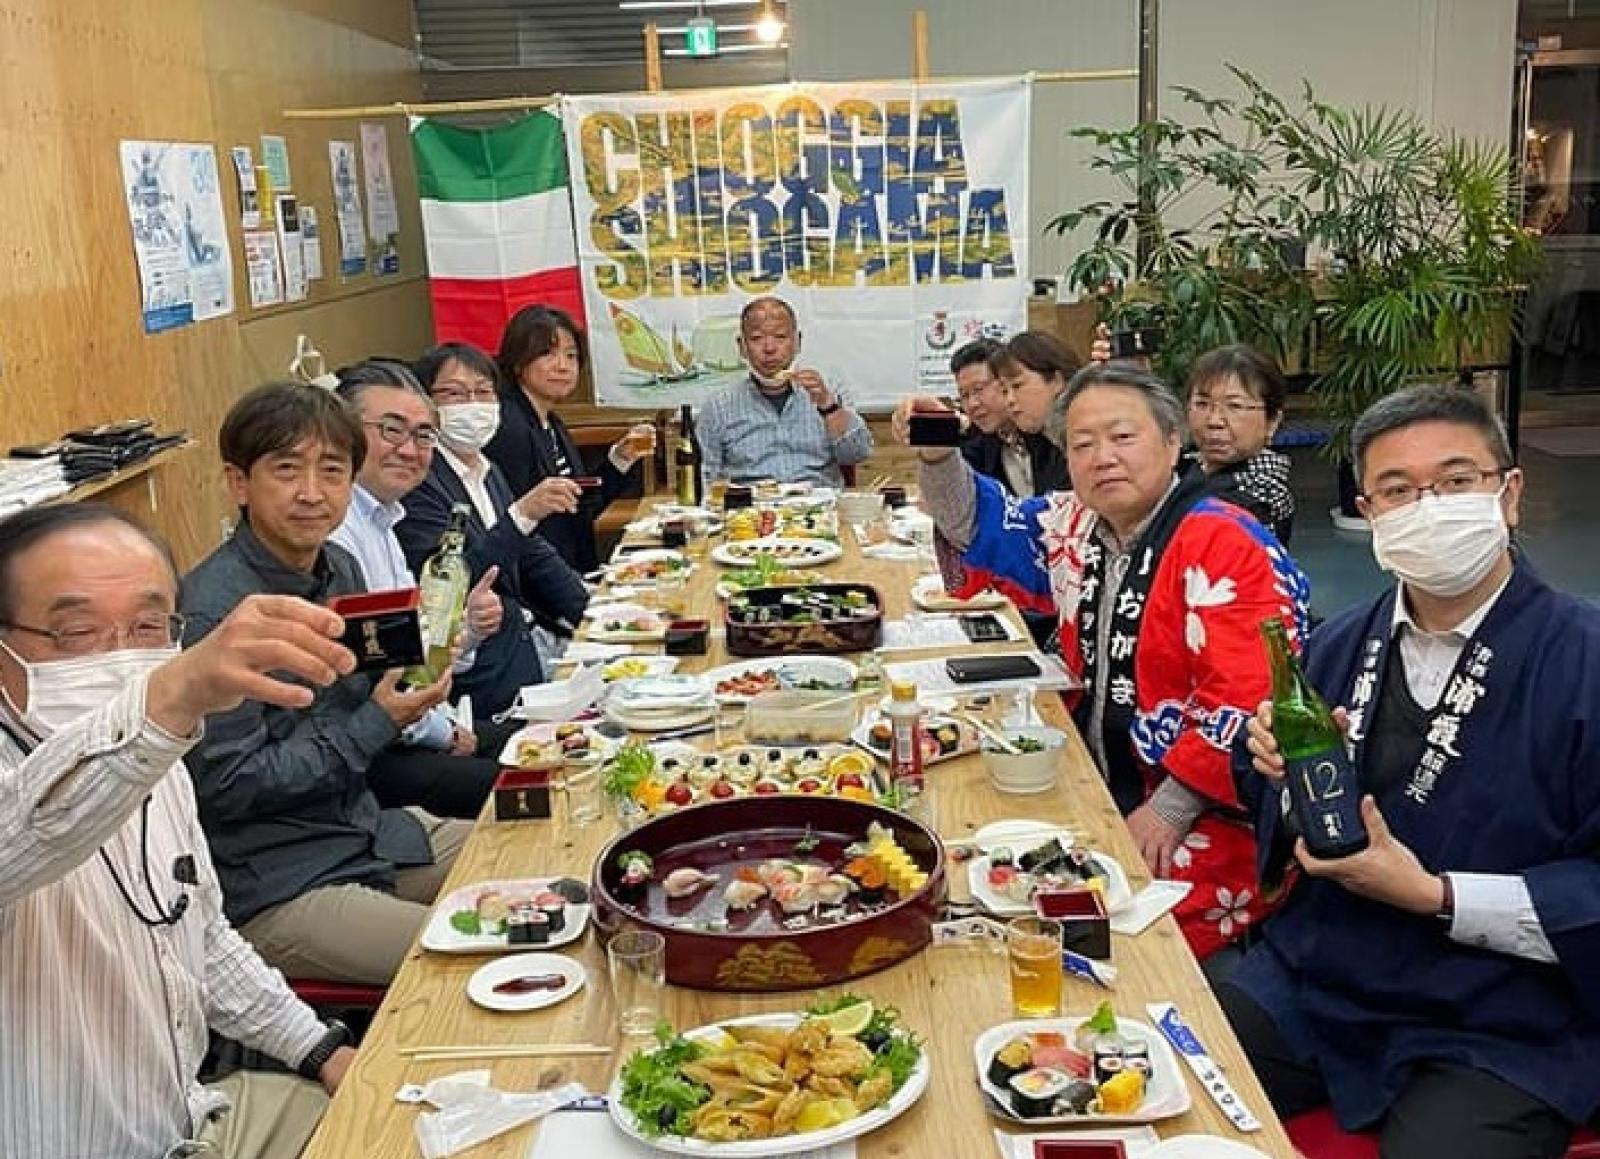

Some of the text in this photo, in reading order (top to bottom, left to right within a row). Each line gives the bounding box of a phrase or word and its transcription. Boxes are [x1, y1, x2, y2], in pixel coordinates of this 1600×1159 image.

[581, 97, 967, 206] CHIOGGIA
[592, 187, 1018, 298] SHIOGAMA
[1303, 760, 1344, 802] 12
